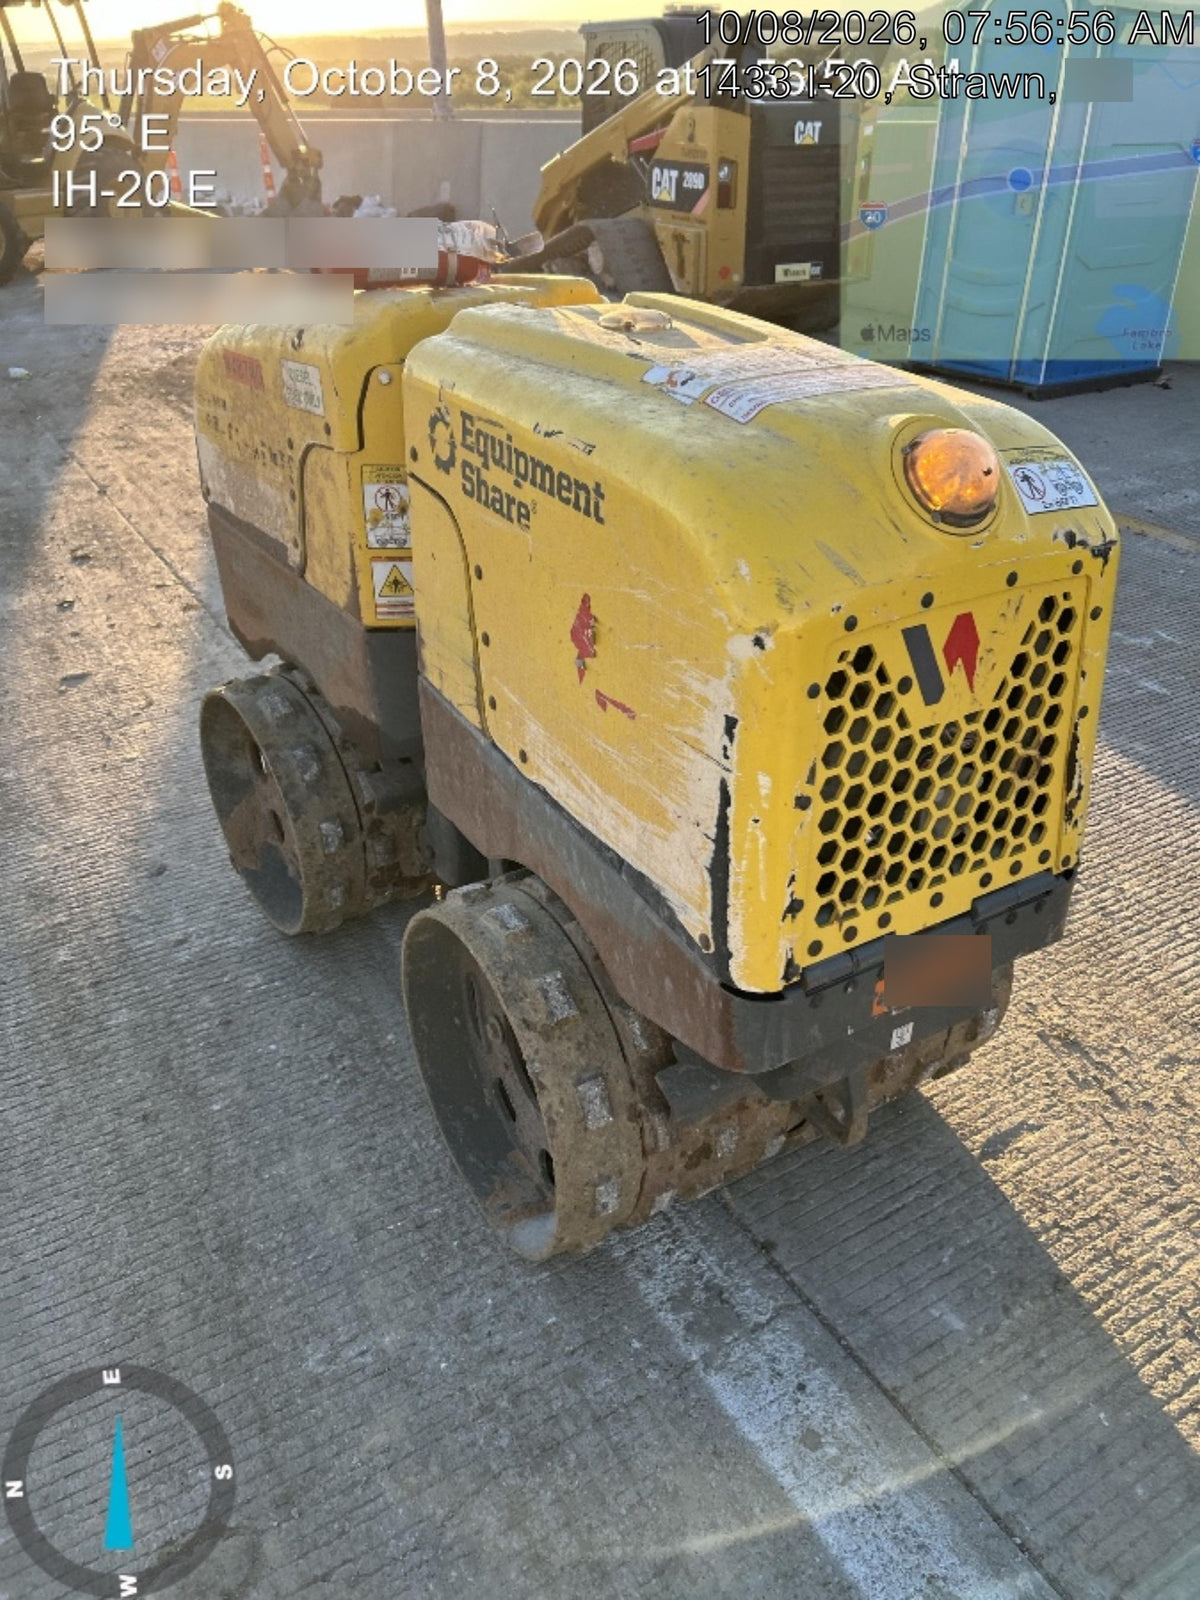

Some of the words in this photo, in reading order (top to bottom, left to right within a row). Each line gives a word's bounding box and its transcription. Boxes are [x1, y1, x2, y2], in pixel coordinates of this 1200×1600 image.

[794, 120, 822, 145] CAT
[652, 165, 679, 202] CAT
[460, 410, 605, 526] Equipment
